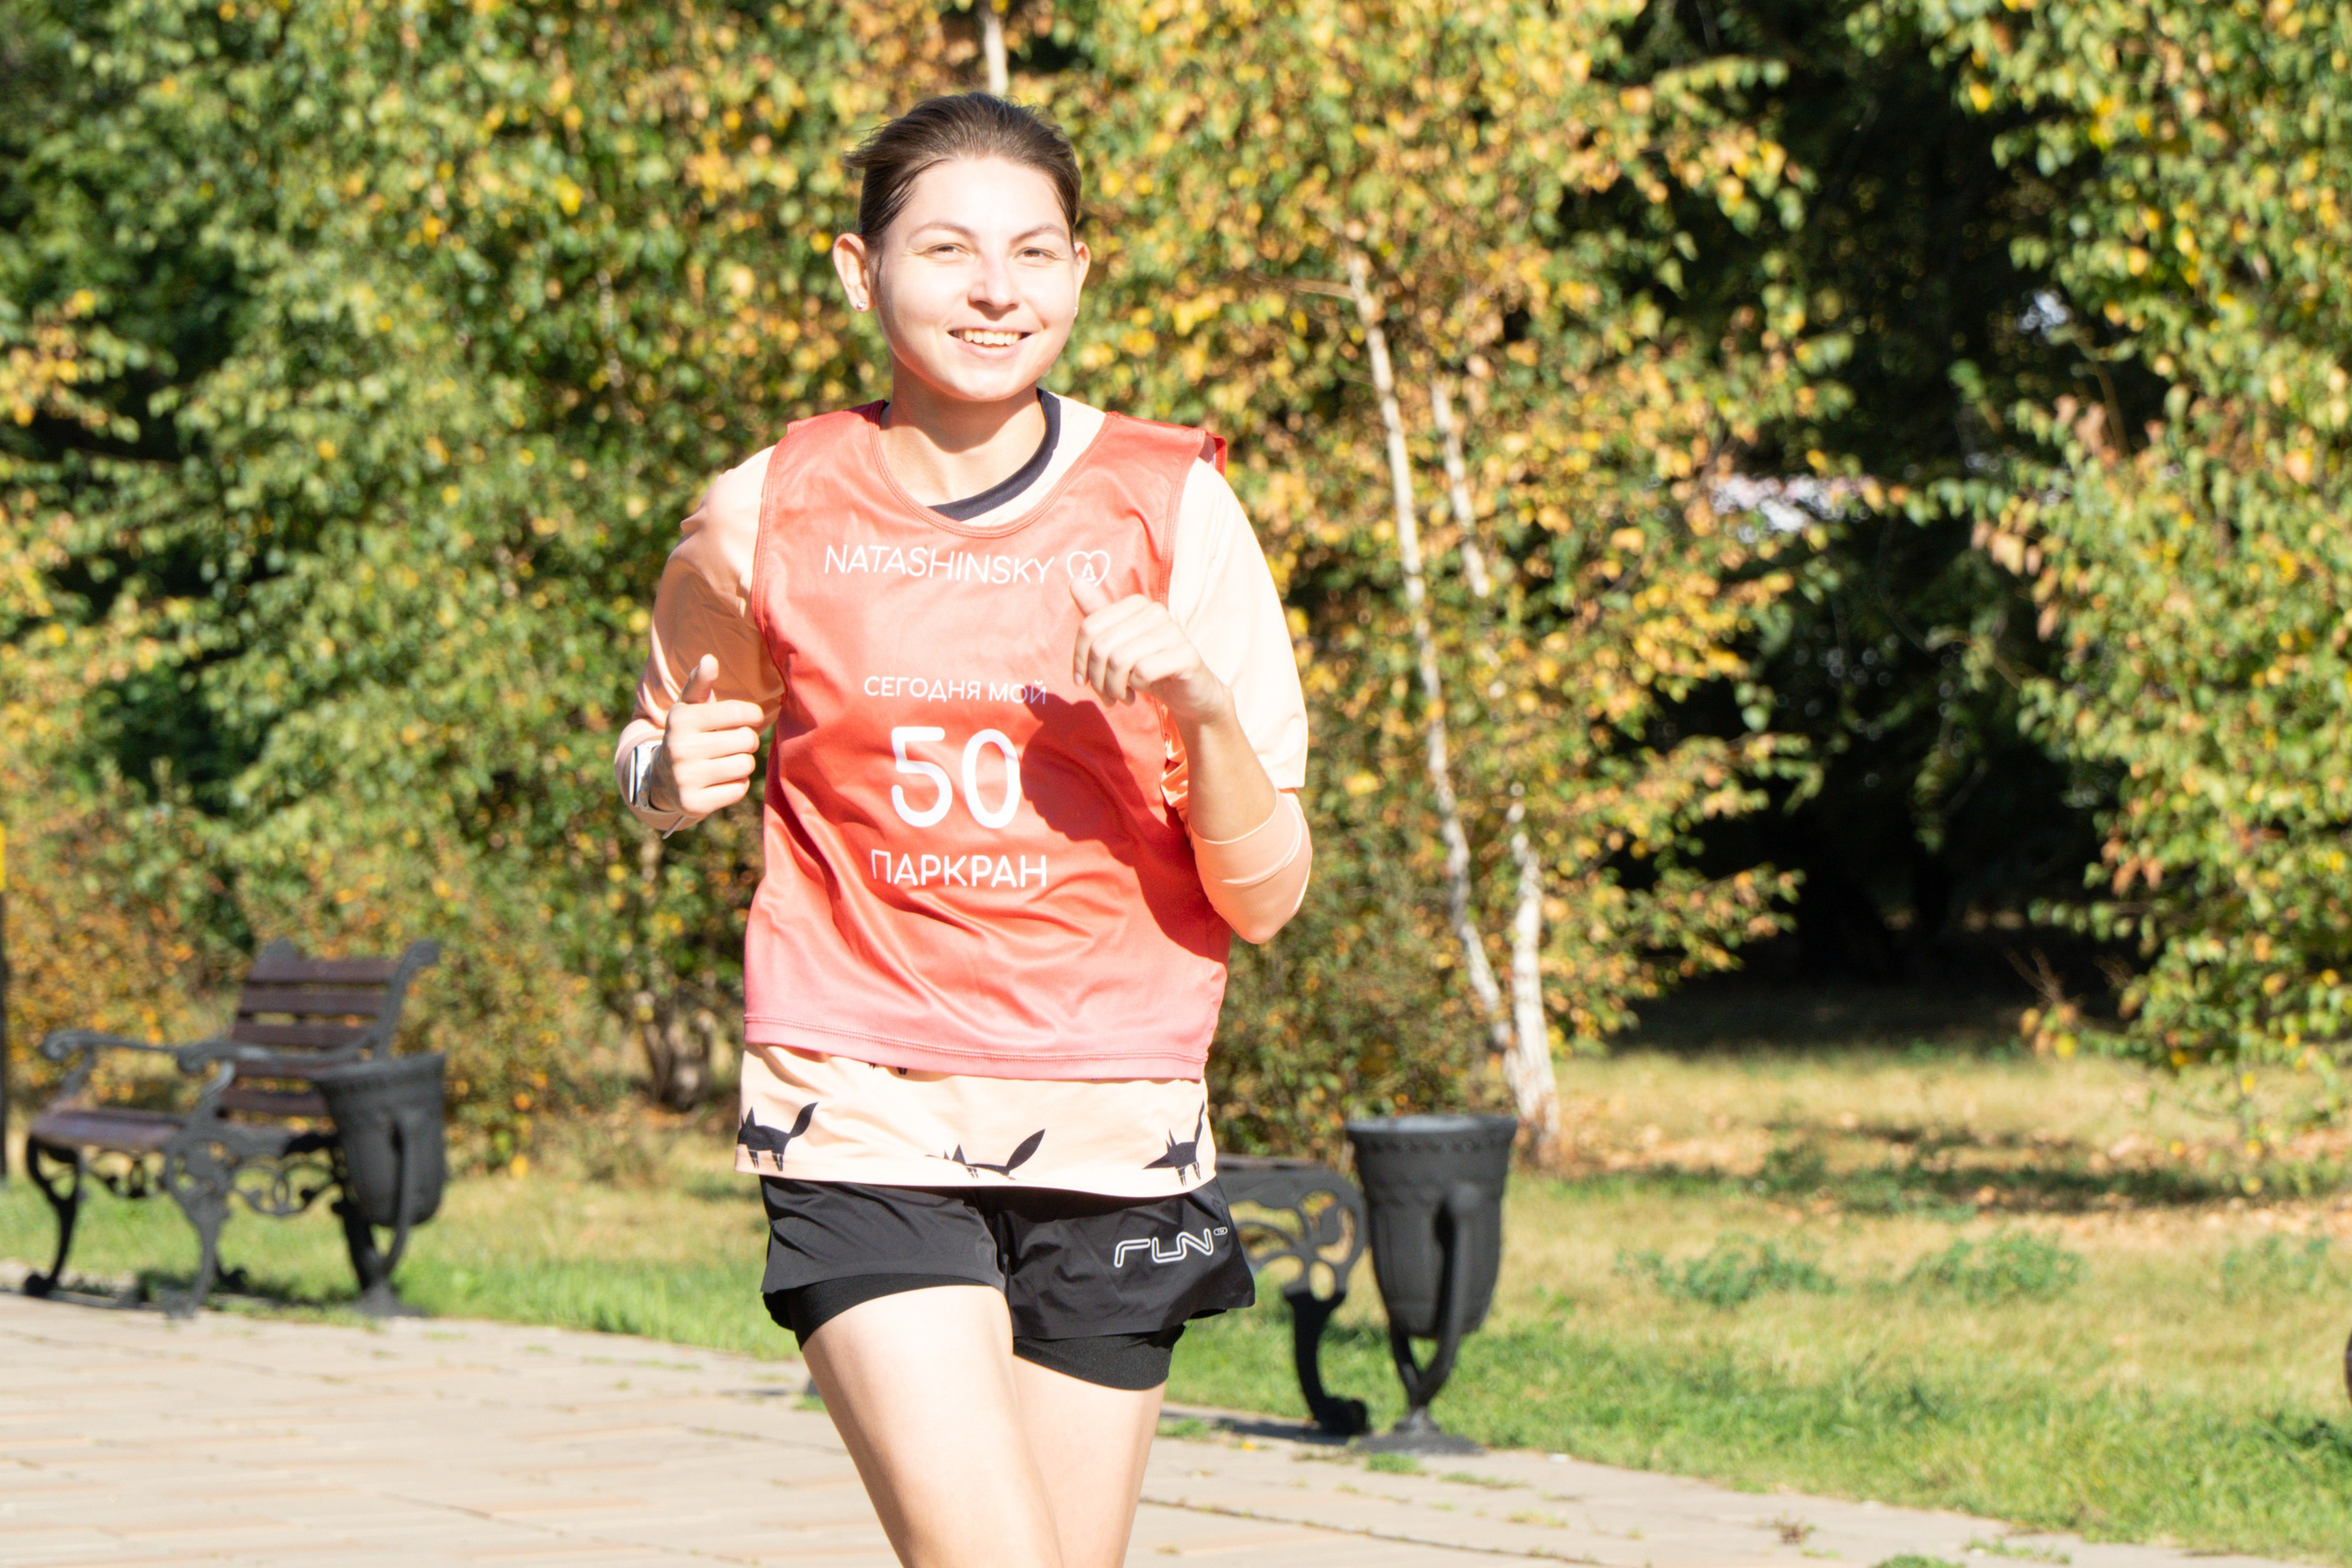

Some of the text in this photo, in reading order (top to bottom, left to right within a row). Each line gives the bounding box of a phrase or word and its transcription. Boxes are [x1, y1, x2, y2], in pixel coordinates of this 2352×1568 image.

[824, 544, 1056, 584] NATASHINSKY
[864, 675, 1046, 705] СЕГОДНЯ МОЙ
[891, 726, 1022, 829] 50
[871, 849, 1047, 887] ПАРКРАН
